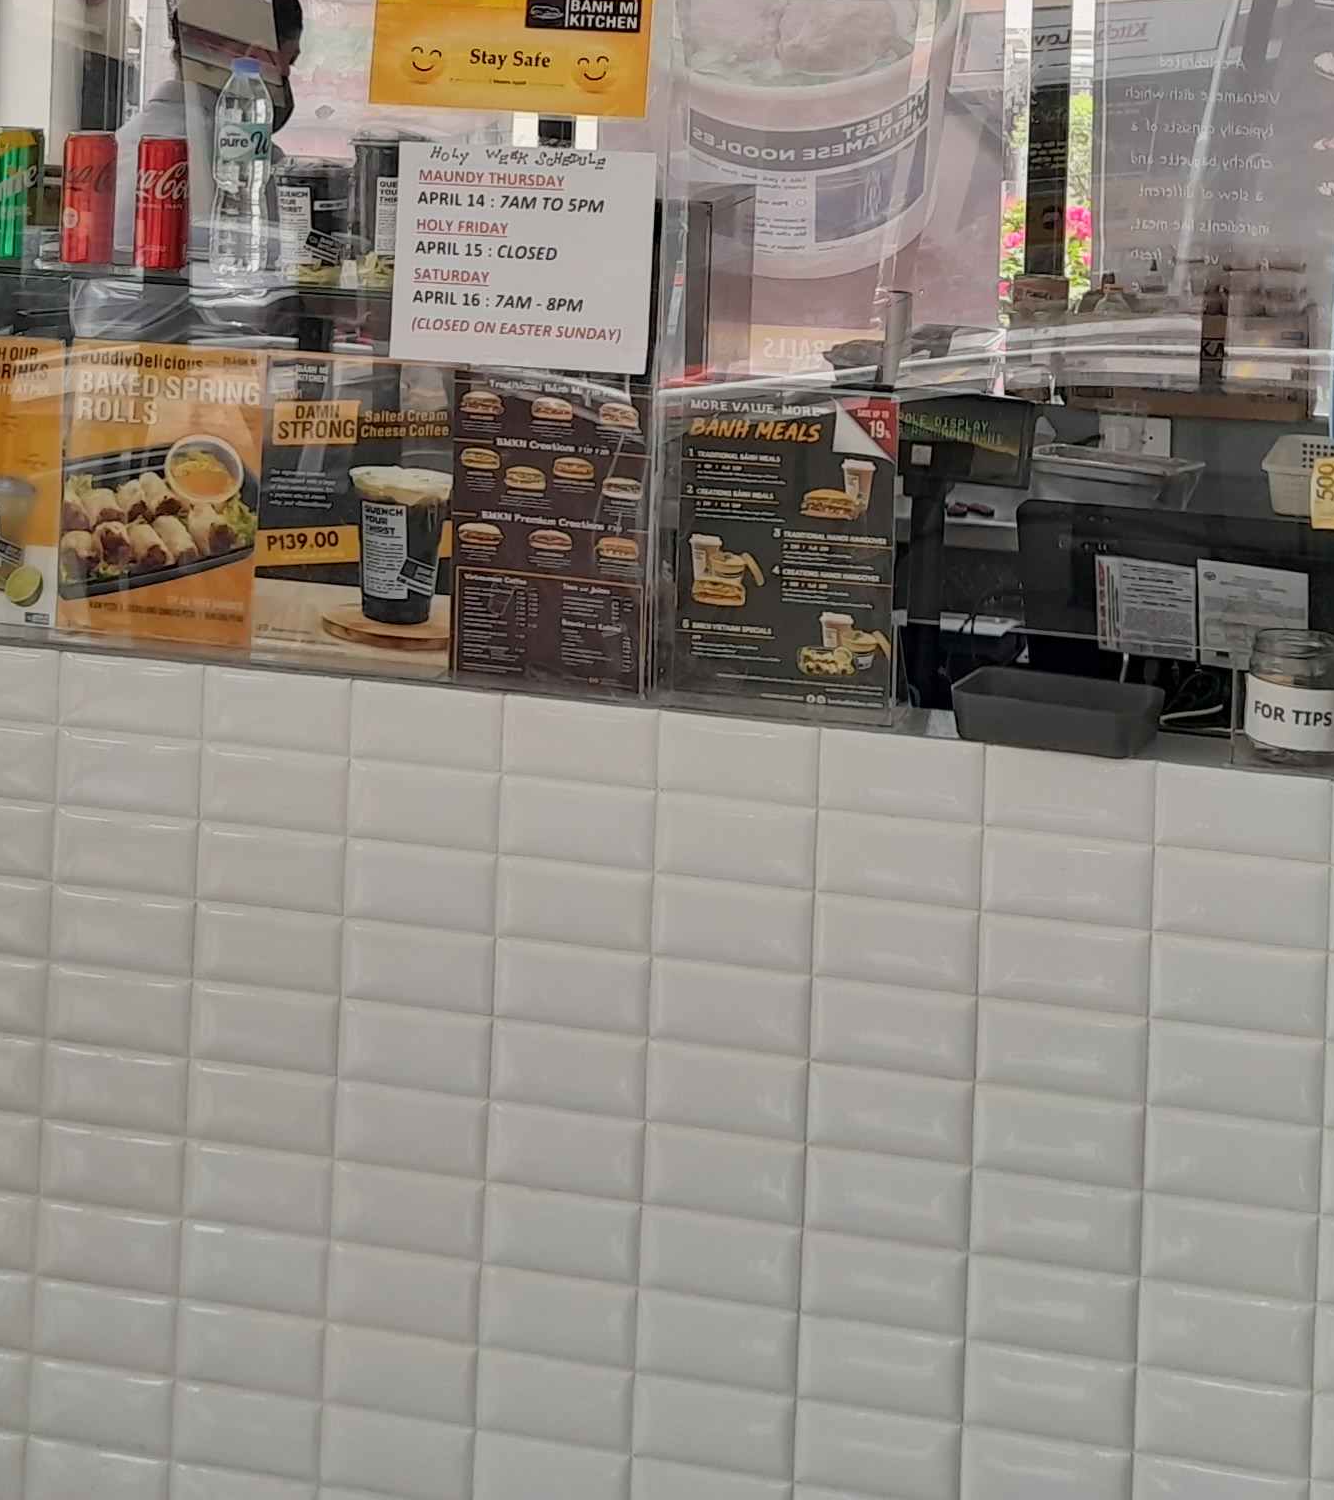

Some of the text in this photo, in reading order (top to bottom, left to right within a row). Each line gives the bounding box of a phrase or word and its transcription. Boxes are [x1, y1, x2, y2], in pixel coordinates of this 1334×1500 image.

[569, 14, 638, 30] KITCHEN
[470, 48, 551, 70] Stay Safe
[220, 136, 249, 149] pure
[418, 169, 565, 188] MAUNDY THURSDAY
[417, 191, 605, 214] APRIL 14 7AM TO 5PM
[416, 218, 508, 236] HOLY FRIDAY
[415, 240, 558, 261] APRIL 15 CLOSED
[413, 267, 490, 283] SATURDAY
[412, 290, 583, 313] APRIL 16 7AM 8PM
[411, 316, 622, 344] (CLOSED ON EASTER SUNDAY)
[9, 347, 39, 362] OUR
[77, 369, 262, 407] BAKED SPRING
[76, 395, 159, 426] ROLLS
[295, 404, 341, 419] DAMN
[364, 409, 449, 423] Salted Cream
[690, 398, 821, 417] MORE VALUE, MORE
[278, 420, 355, 440] STRONG
[360, 424, 406, 439] Cheese
[409, 423, 450, 438] Coffee
[754, 418, 822, 443] MEALS
[934, 415, 989, 432] DISPLAY
[266, 530, 339, 551] P139.00
[1253, 699, 1333, 729] FOR TIPS
